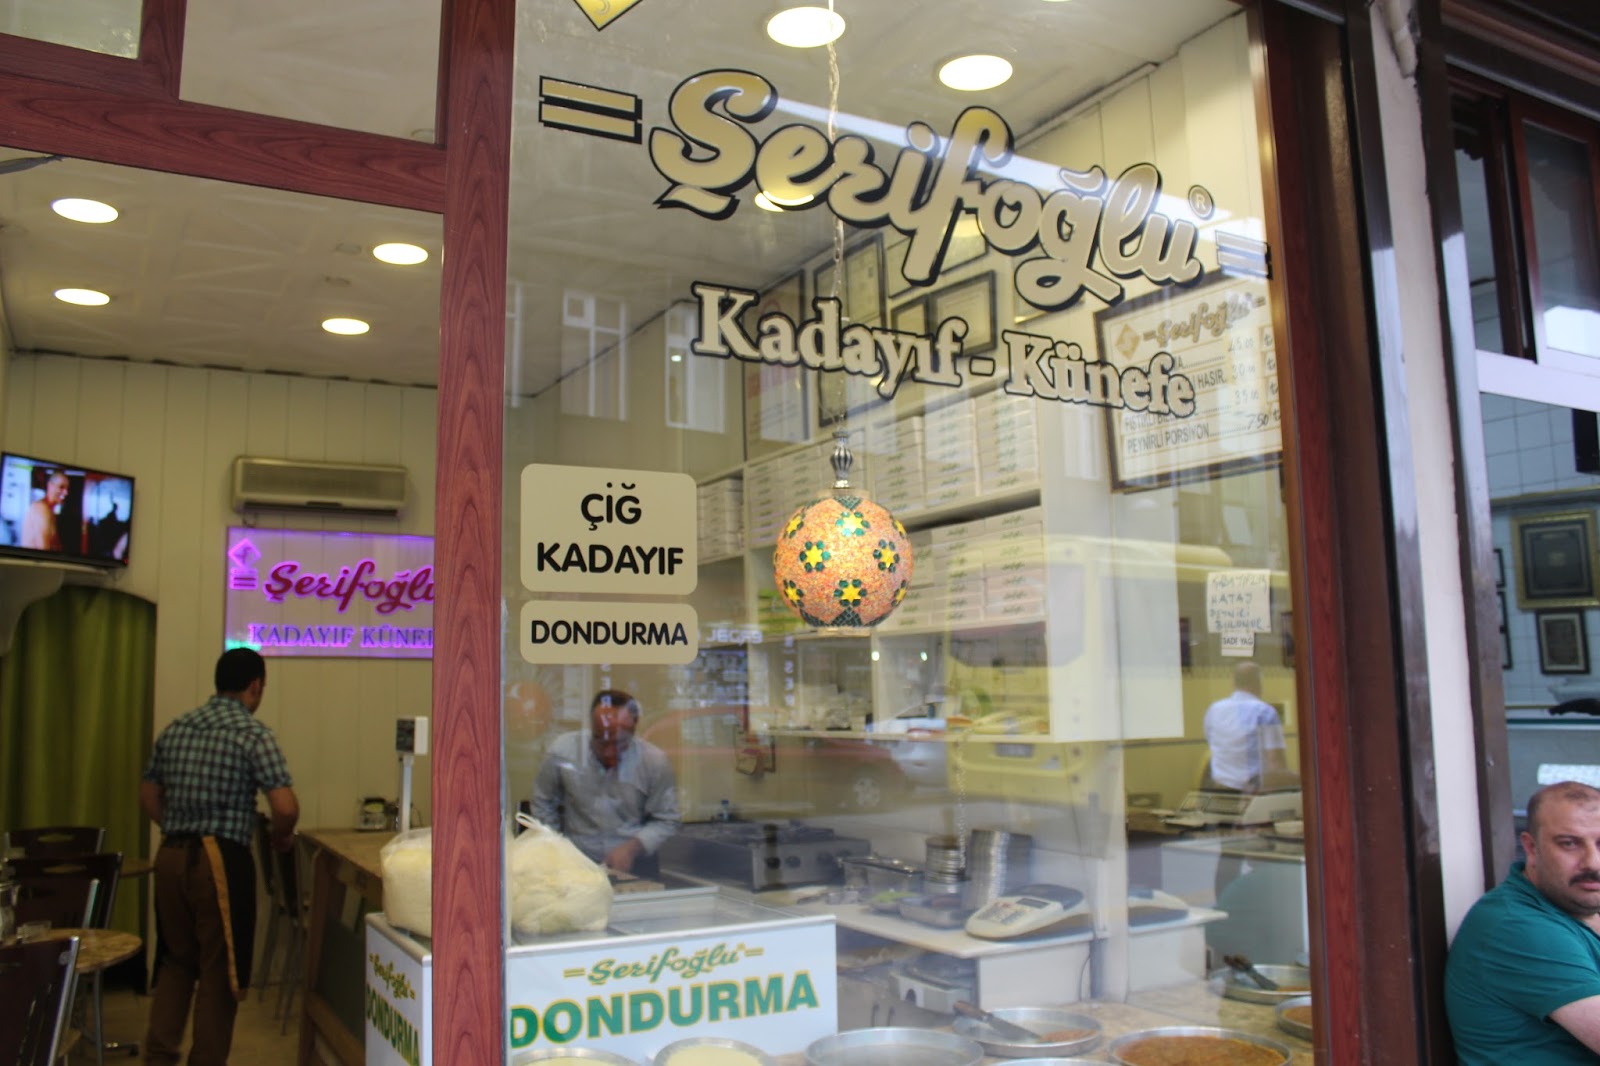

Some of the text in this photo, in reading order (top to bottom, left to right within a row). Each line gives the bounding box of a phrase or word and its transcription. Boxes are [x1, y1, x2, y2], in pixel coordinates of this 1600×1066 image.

[648, 69, 1202, 312] Şerifoğlu
[691, 281, 968, 400] Kadayıf
[1002, 330, 1196, 418] Künefe
[581, 482, 642, 531] ÇİĞ
[537, 542, 684, 575] KADAYIF
[250, 624, 353, 647] KADAYIF
[531, 620, 688, 646] DONDURMA
[588, 943, 740, 985] Şerifoğlu
[511, 969, 819, 1049] DONDURMA
